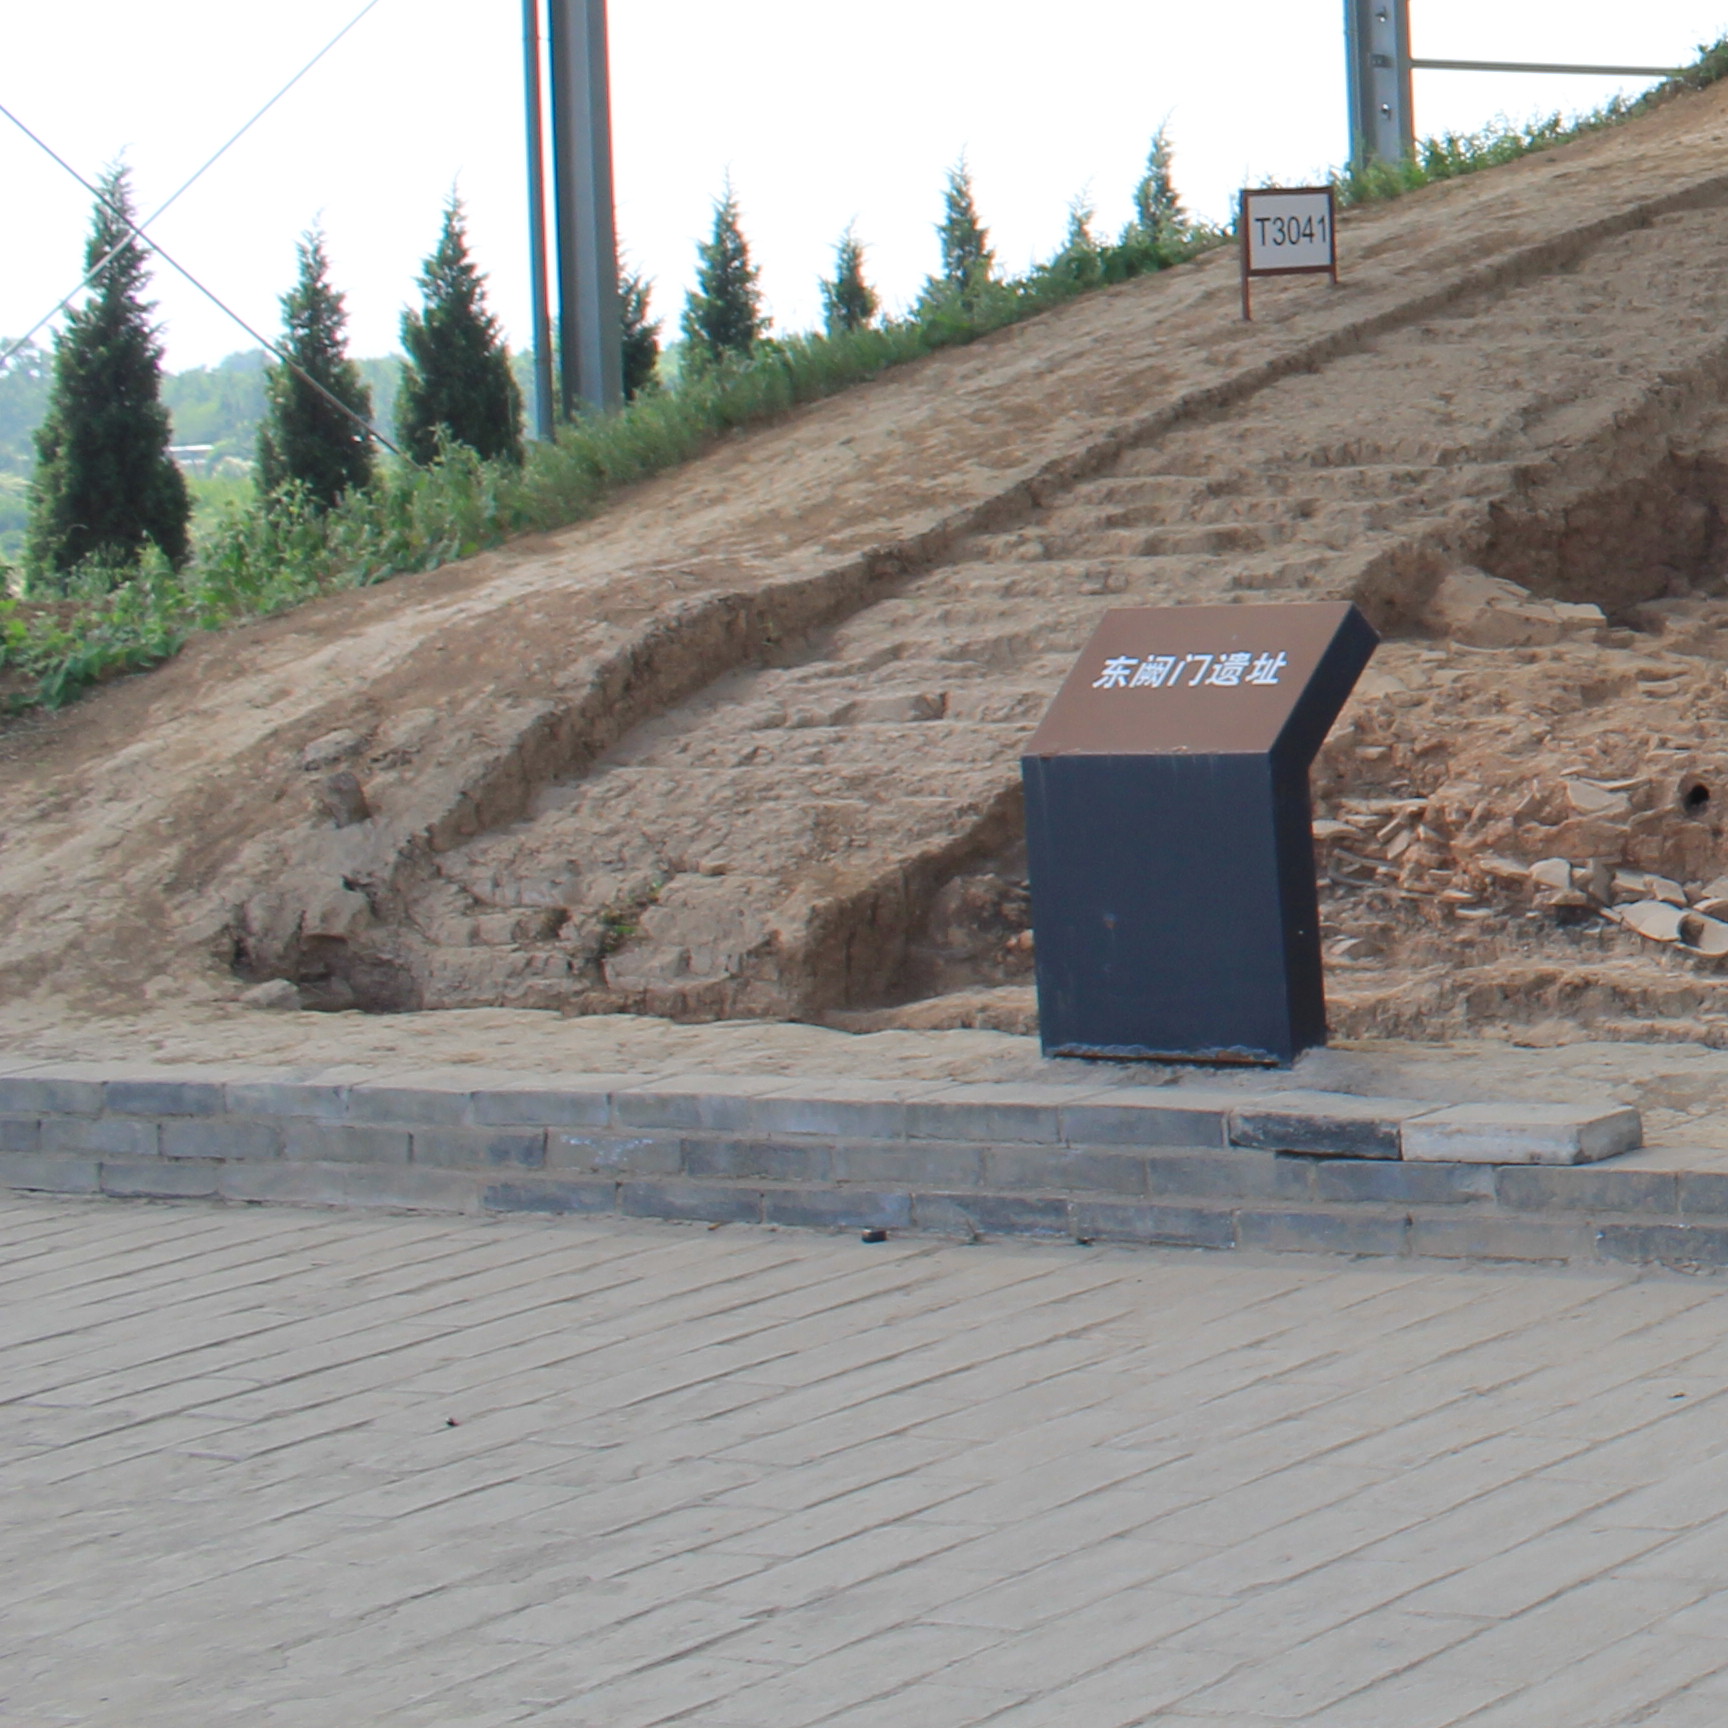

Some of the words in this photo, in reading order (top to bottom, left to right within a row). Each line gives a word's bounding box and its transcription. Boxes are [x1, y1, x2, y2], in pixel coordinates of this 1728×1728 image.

[1254, 215, 1327, 246] T3041
[1092, 650, 1287, 688] 东阙门遗址
